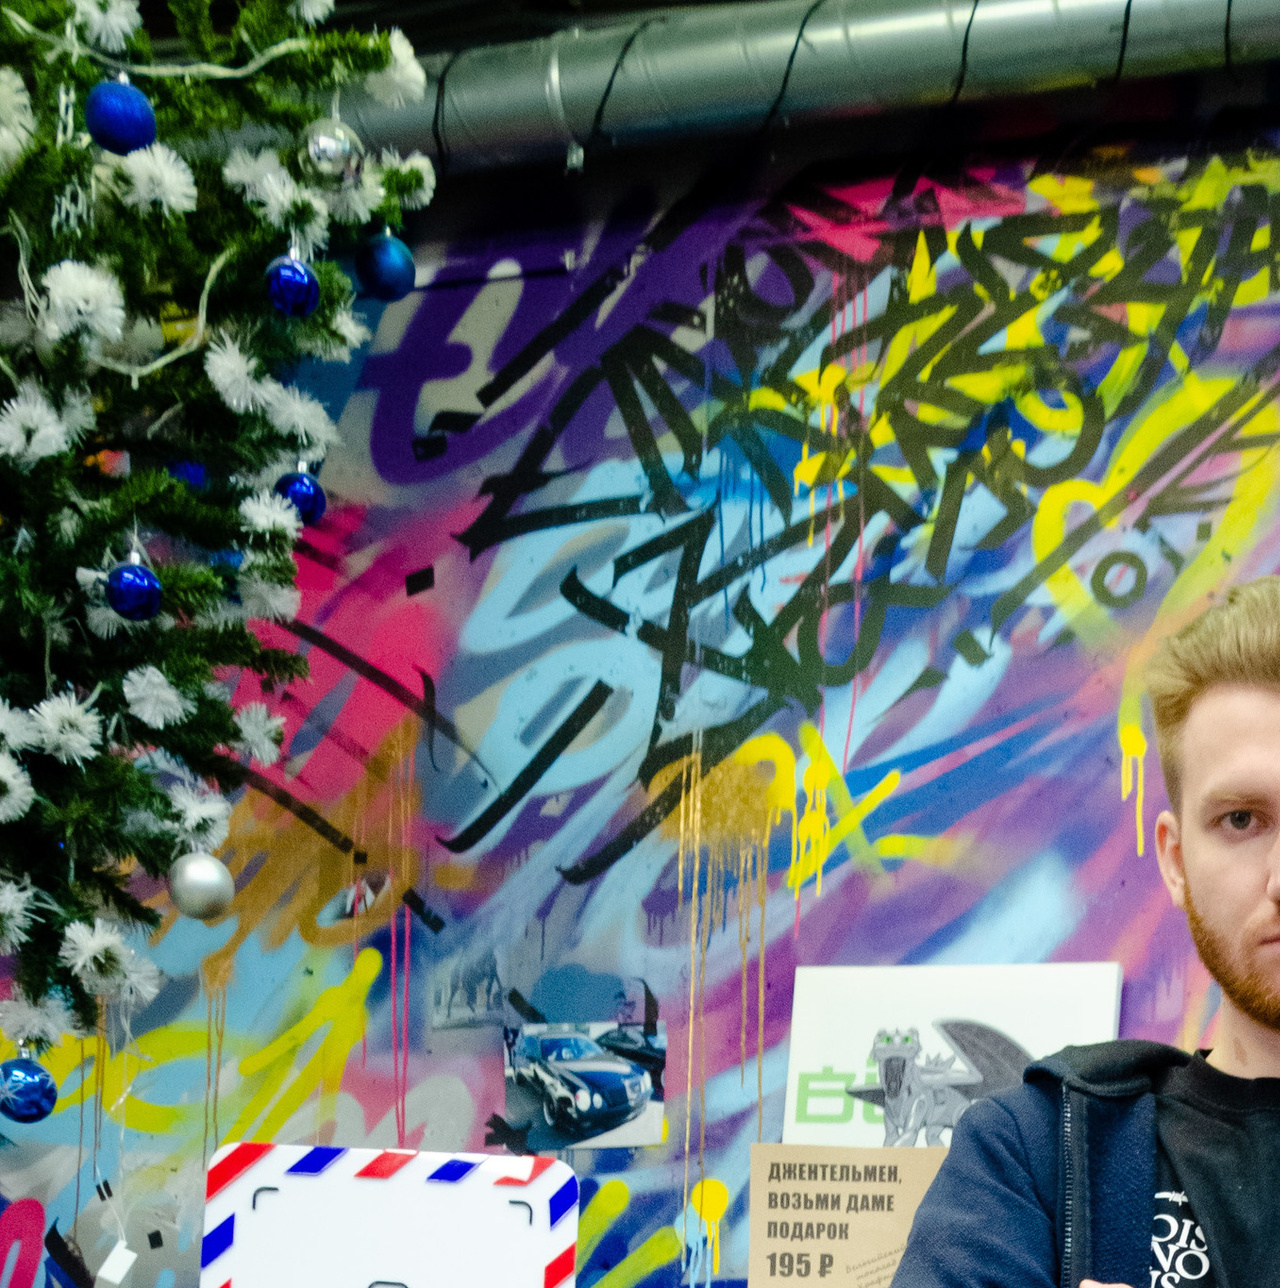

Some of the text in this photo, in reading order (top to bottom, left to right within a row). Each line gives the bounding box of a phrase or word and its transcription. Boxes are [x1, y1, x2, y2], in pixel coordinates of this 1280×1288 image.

[768, 1162, 902, 1184] ДЖЕНТЕЛЬМЕН,
[768, 1192, 895, 1213] ВОЗЬМИ ДАМЕ
[767, 1221, 849, 1242] ПОДАРОК
[766, 1252, 811, 1278] 195
